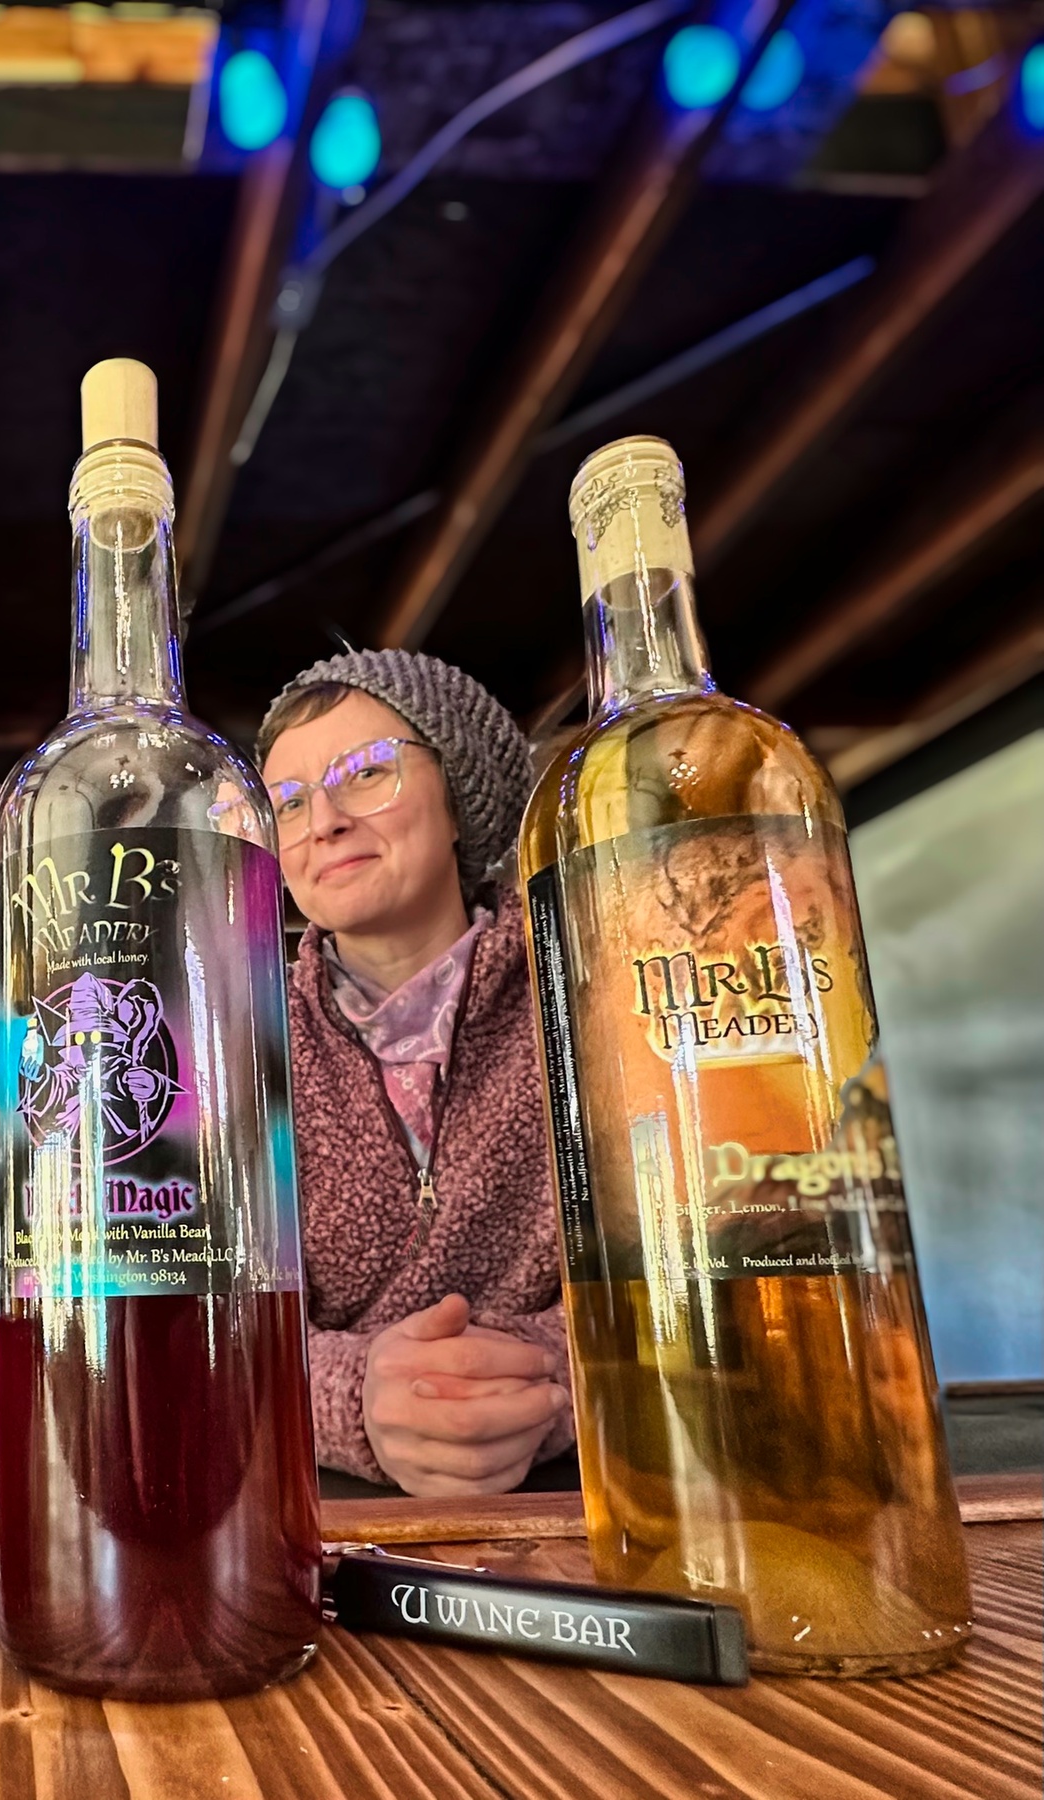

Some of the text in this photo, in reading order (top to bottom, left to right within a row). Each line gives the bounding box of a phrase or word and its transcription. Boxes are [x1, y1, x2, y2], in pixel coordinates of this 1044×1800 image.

[47, 950, 150, 974] Made with local honey.
[106, 1177, 194, 1220] Magic
[581, 1186, 589, 1201] No
[103, 1222, 130, 1241] with
[130, 1221, 177, 1241] Vanilla
[108, 1248, 124, 1268] by
[125, 1250, 149, 1265] Mr.
[150, 1248, 170, 1264] B's
[209, 1247, 235, 1263] LLC
[742, 1253, 795, 1269] Produced
[795, 1252, 816, 1267] and
[149, 1267, 187, 1286] 98134
[390, 1584, 430, 1625] U
[550, 1609, 639, 1658] BAR
